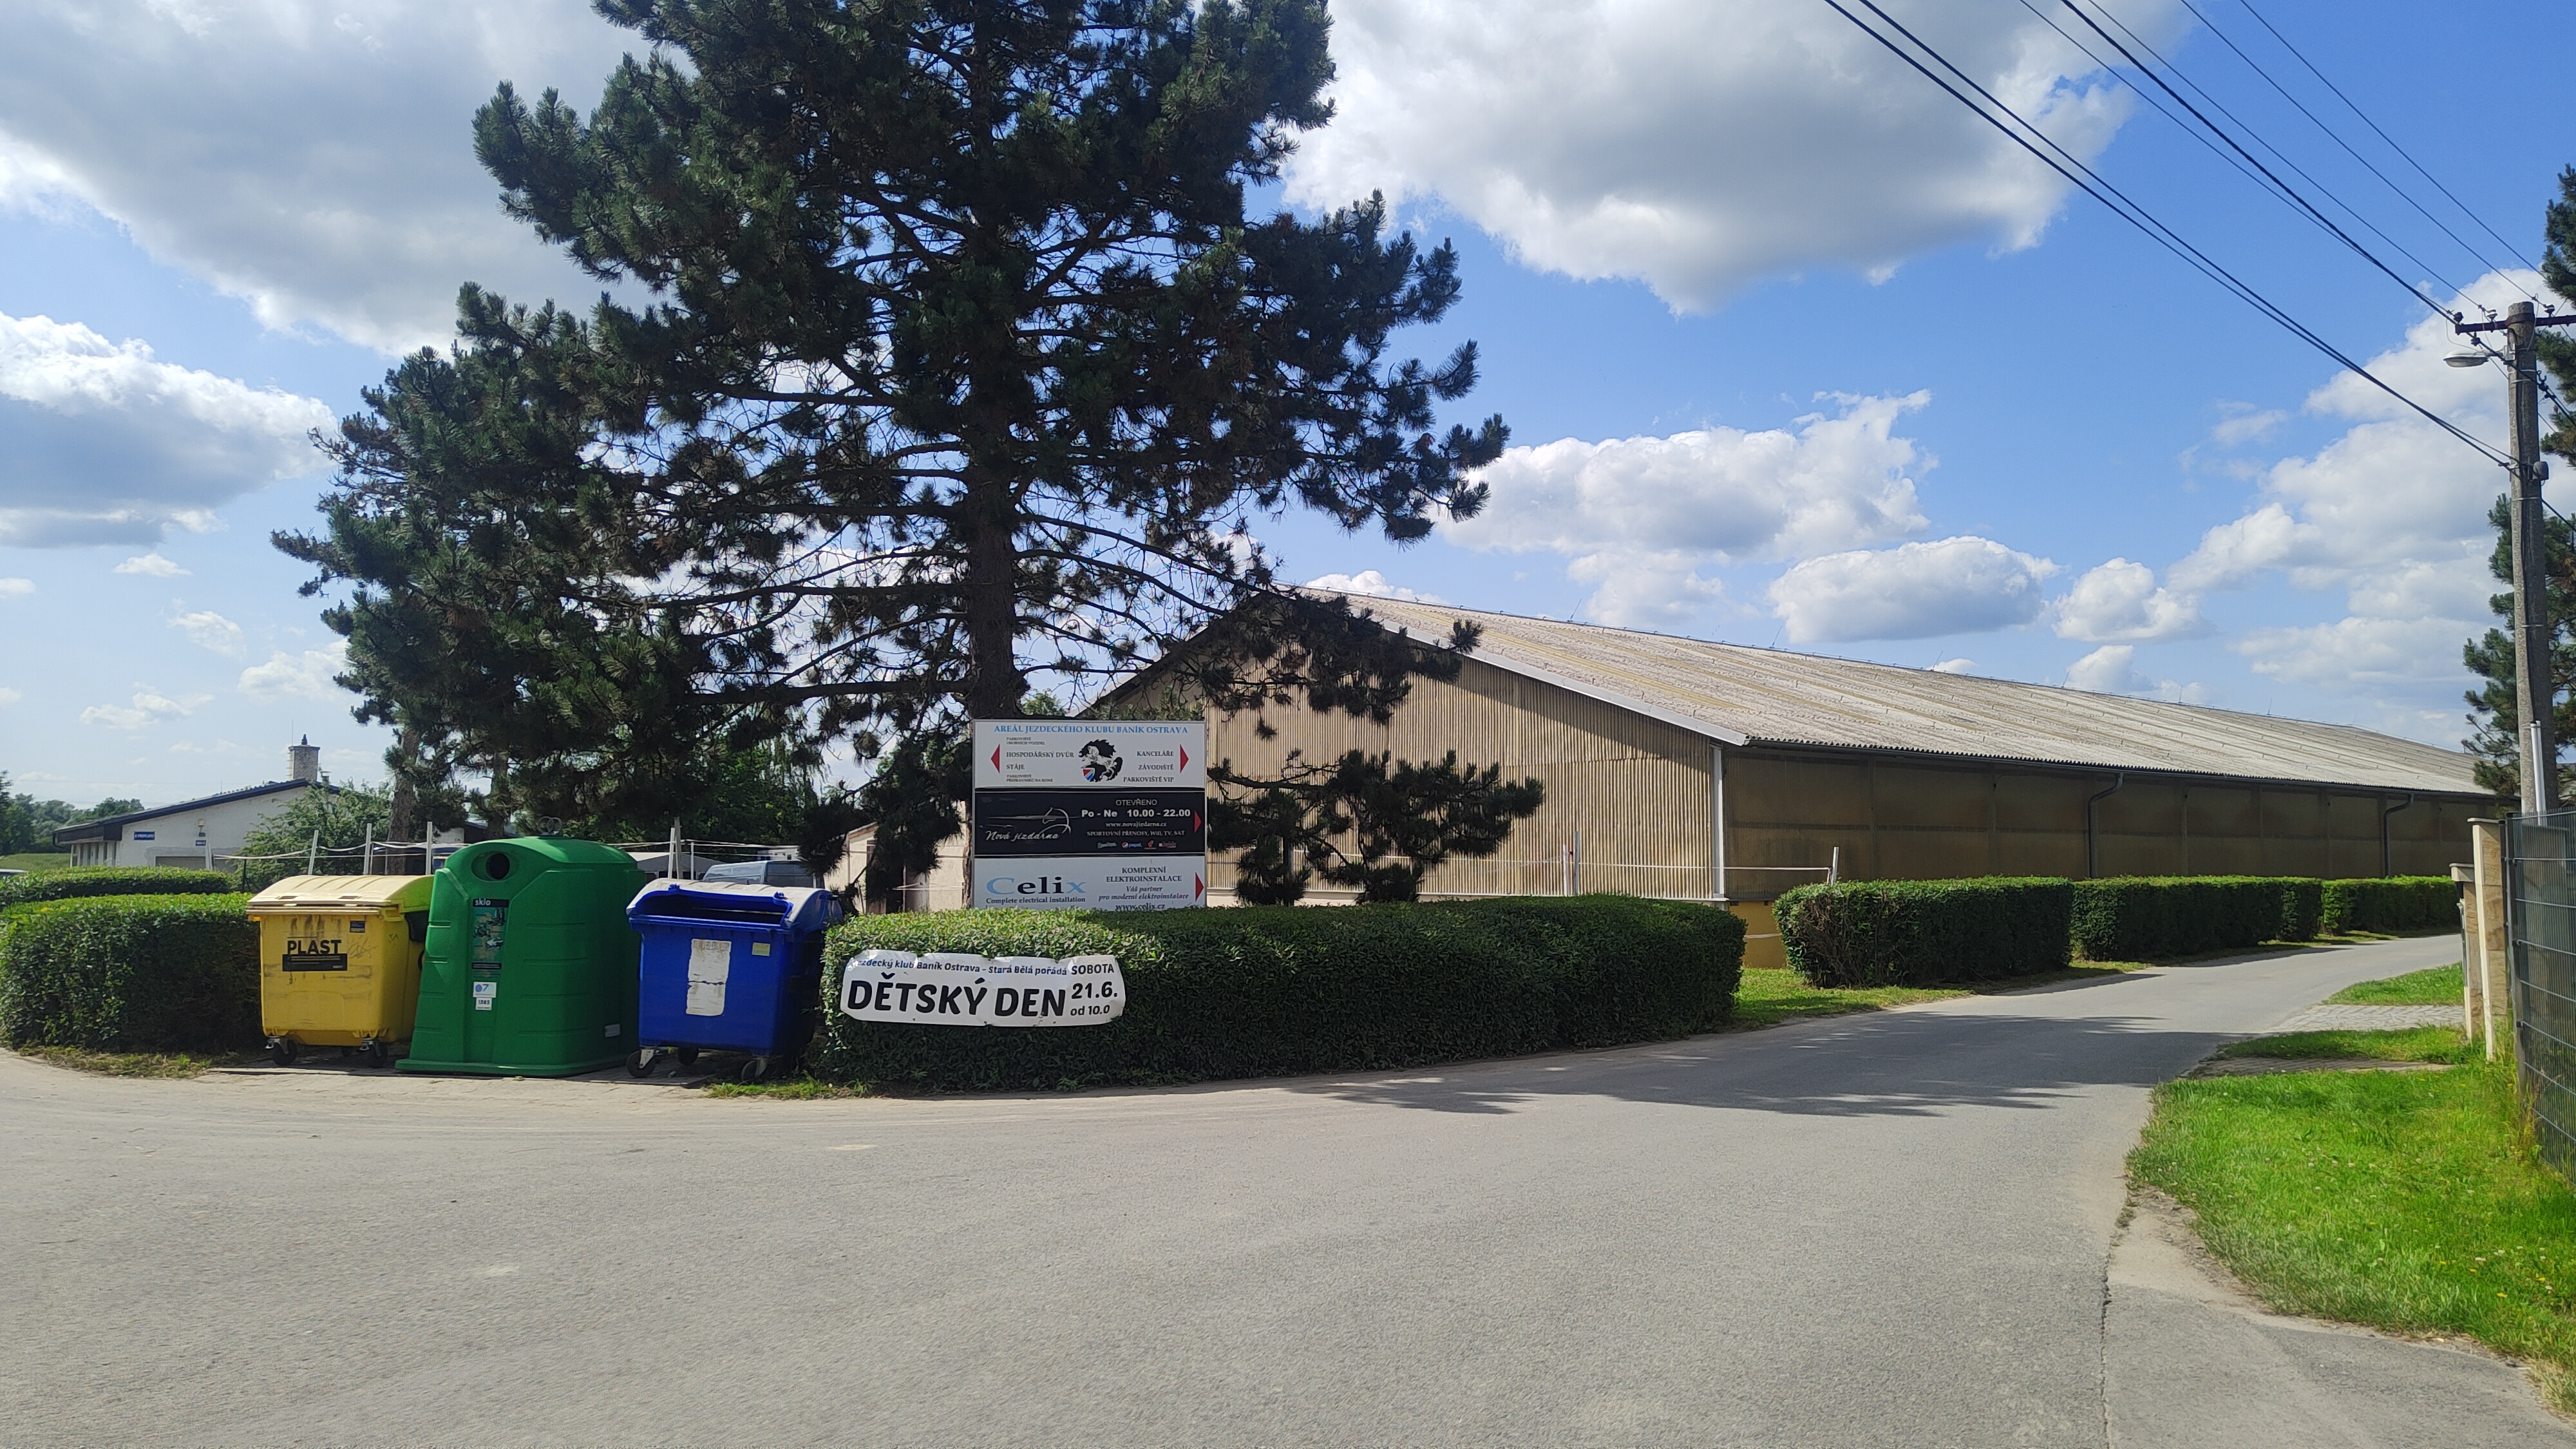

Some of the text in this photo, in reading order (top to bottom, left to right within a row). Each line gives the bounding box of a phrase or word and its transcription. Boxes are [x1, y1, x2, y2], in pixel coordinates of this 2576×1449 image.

[994, 724, 1023, 732] AREÁL
[1025, 724, 1083, 734] JEZDECKÉHO
[1081, 810, 1094, 818] Po
[1127, 809, 1155, 817] 10.00
[1163, 809, 1191, 817] 22.00
[985, 831, 1010, 841] Nová
[986, 876, 1086, 895] Celix
[475, 898, 491, 906] sklo
[1115, 902, 1166, 911] www.celix.cz
[287, 940, 342, 955] PLAST
[895, 960, 914, 969] klub
[916, 961, 942, 971] Baník
[944, 963, 980, 972] Ostrava
[988, 965, 1012, 974] Stará
[1014, 965, 1033, 974] Bělá
[1034, 966, 1067, 976] pořádá
[1071, 963, 1115, 975] SOBOTA
[848, 971, 1066, 1017] DĚTSKÝ DEN
[1071, 981, 1118, 999] 21.6.
[1070, 1006, 1085, 1016] od
